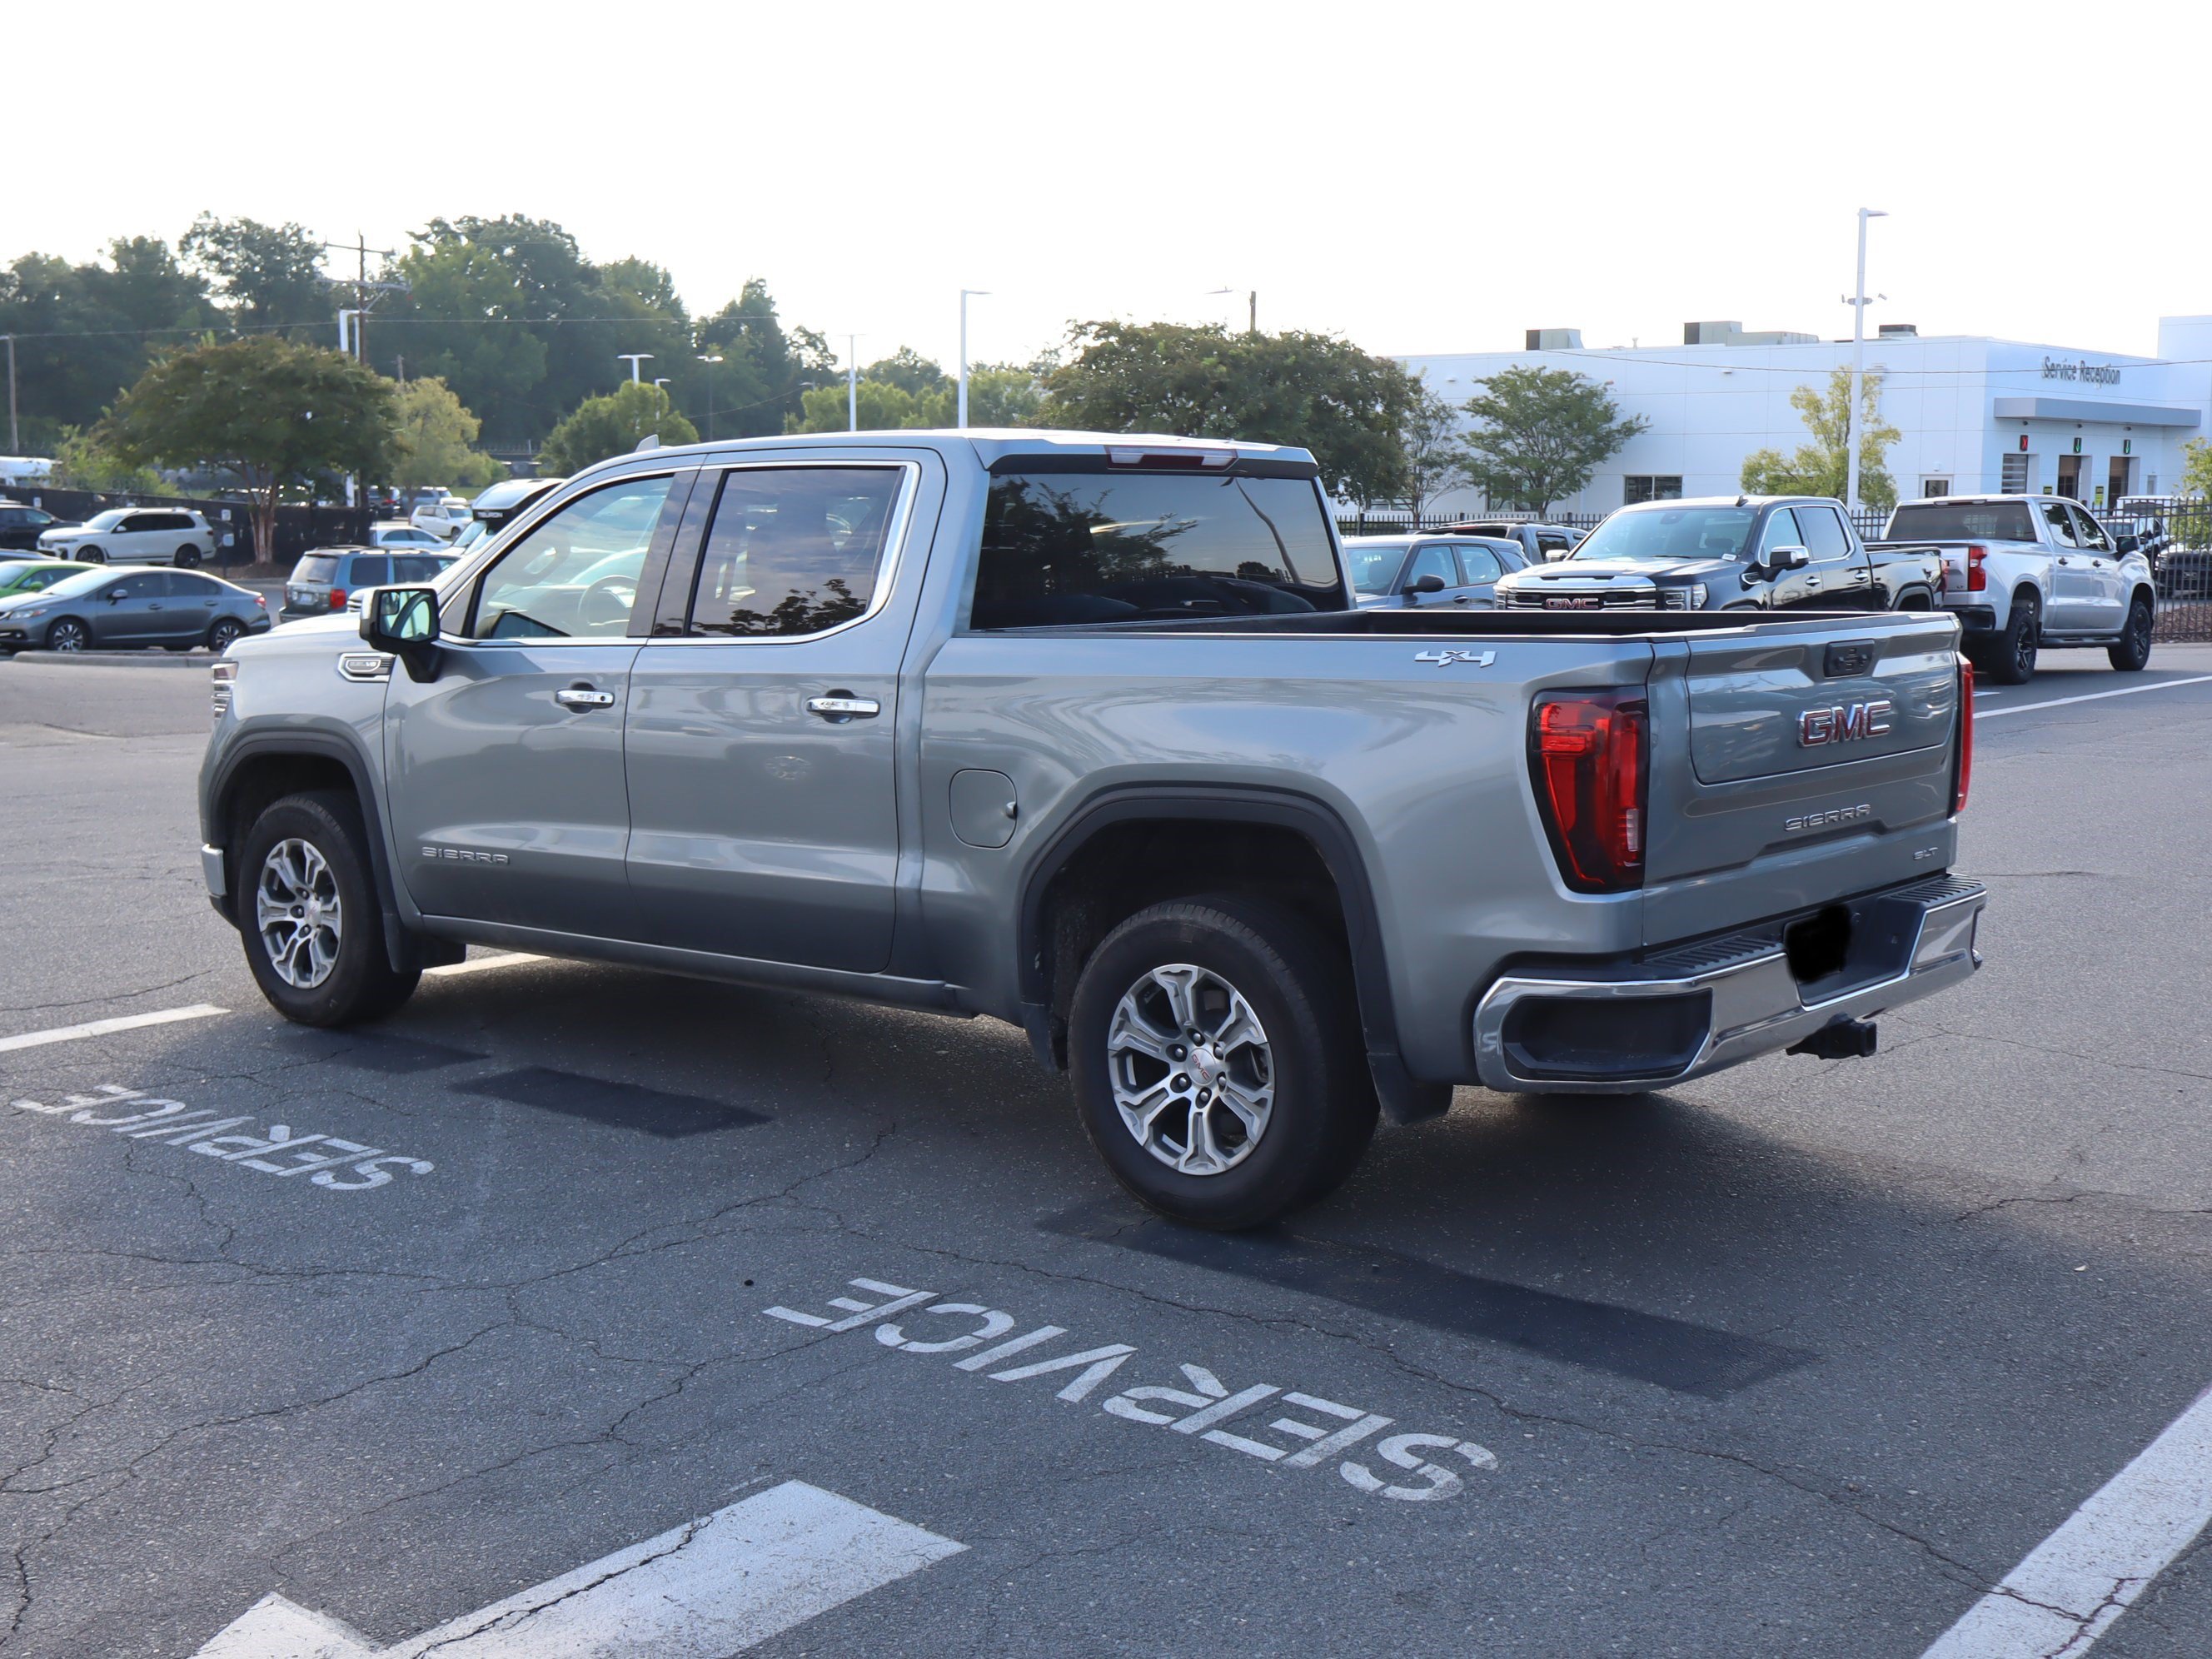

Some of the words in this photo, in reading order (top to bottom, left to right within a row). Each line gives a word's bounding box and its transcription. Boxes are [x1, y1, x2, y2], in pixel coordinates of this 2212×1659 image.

[2042, 356, 2077, 381] Service
[2080, 360, 2120, 389] Reception
[1546, 598, 1599, 610] GMC
[1797, 700, 1891, 747] GMC
[1785, 804, 1871, 831] SIERRA
[421, 846, 509, 864] SIERRA
[1913, 847, 1938, 860] SLT
[1192, 1054, 1211, 1080] GMC
[10, 1084, 435, 1191] SERVICE
[762, 1277, 1500, 1501] SERVICE
